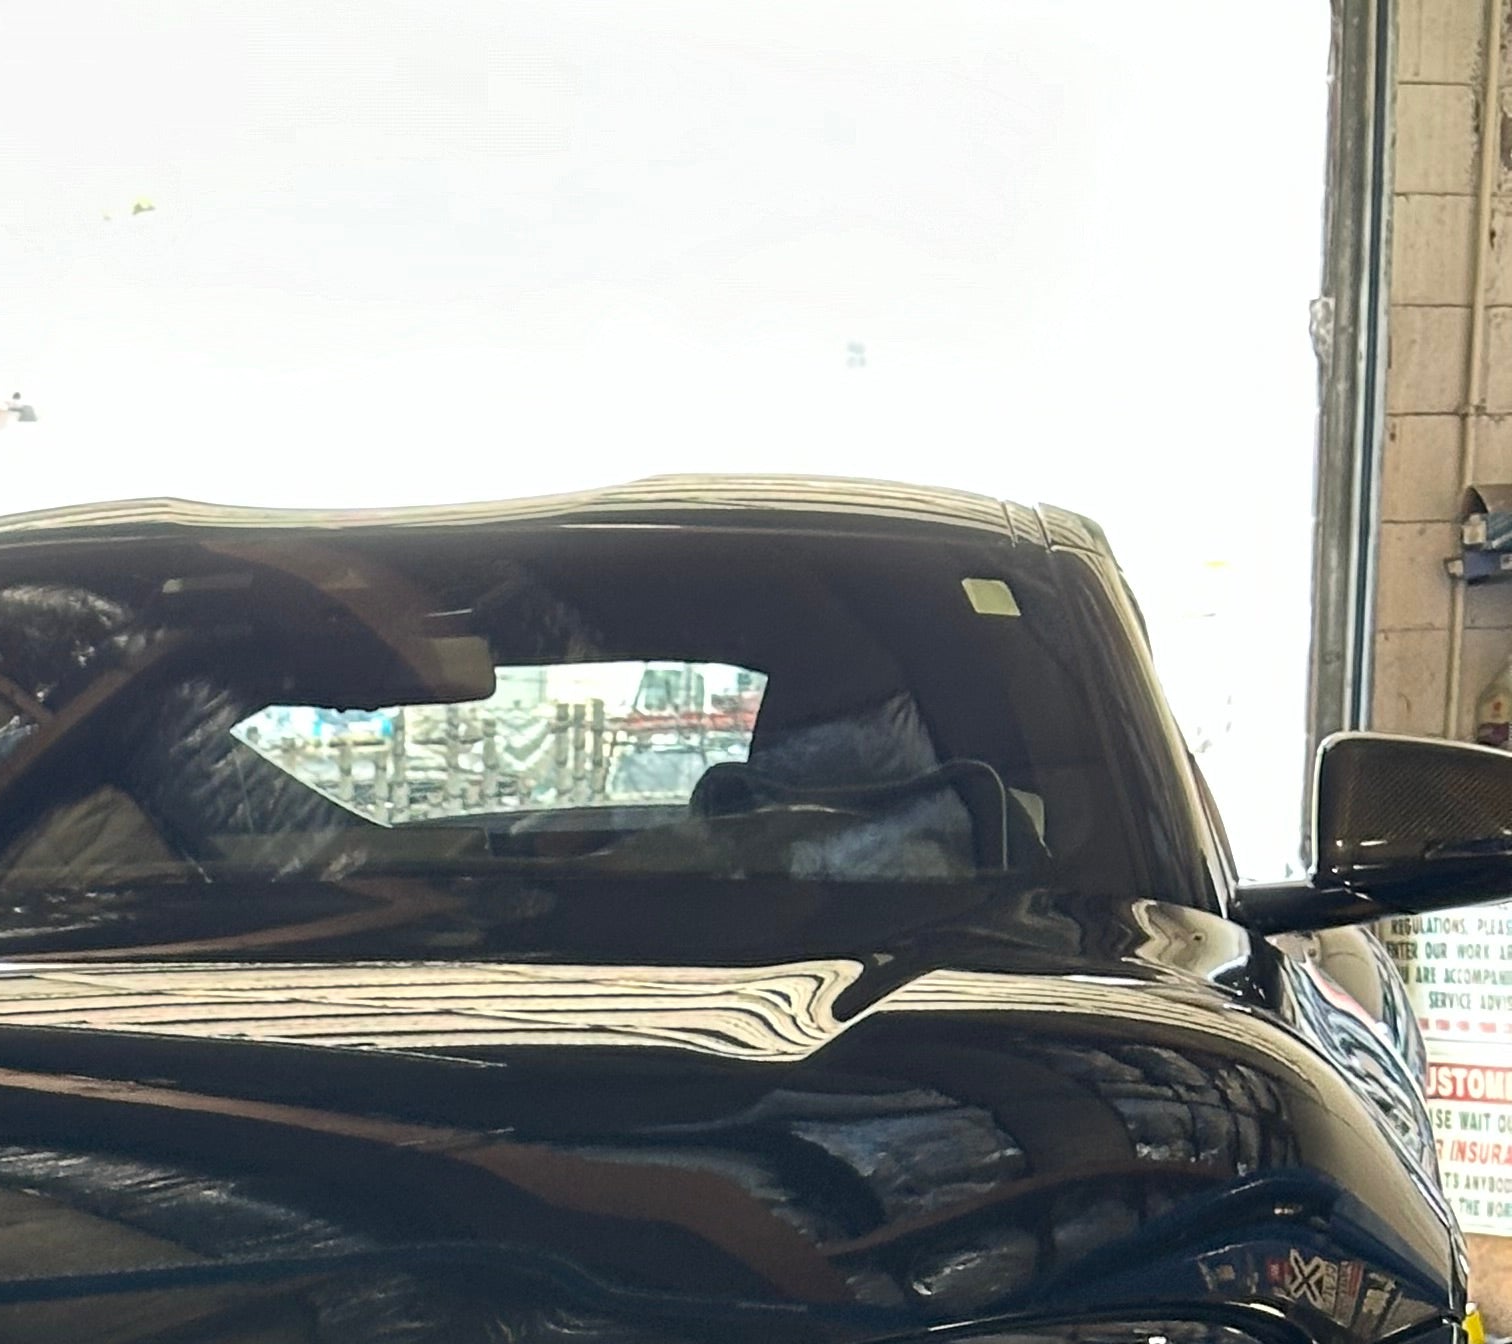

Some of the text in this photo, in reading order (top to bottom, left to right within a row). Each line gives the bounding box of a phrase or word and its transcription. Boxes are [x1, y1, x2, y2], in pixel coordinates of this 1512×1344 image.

[1457, 944, 1490, 959] WORK
[1416, 966, 1436, 984] ARE
[1429, 991, 1471, 1009] SERVICE
[1459, 1111, 1491, 1132] WAIT
